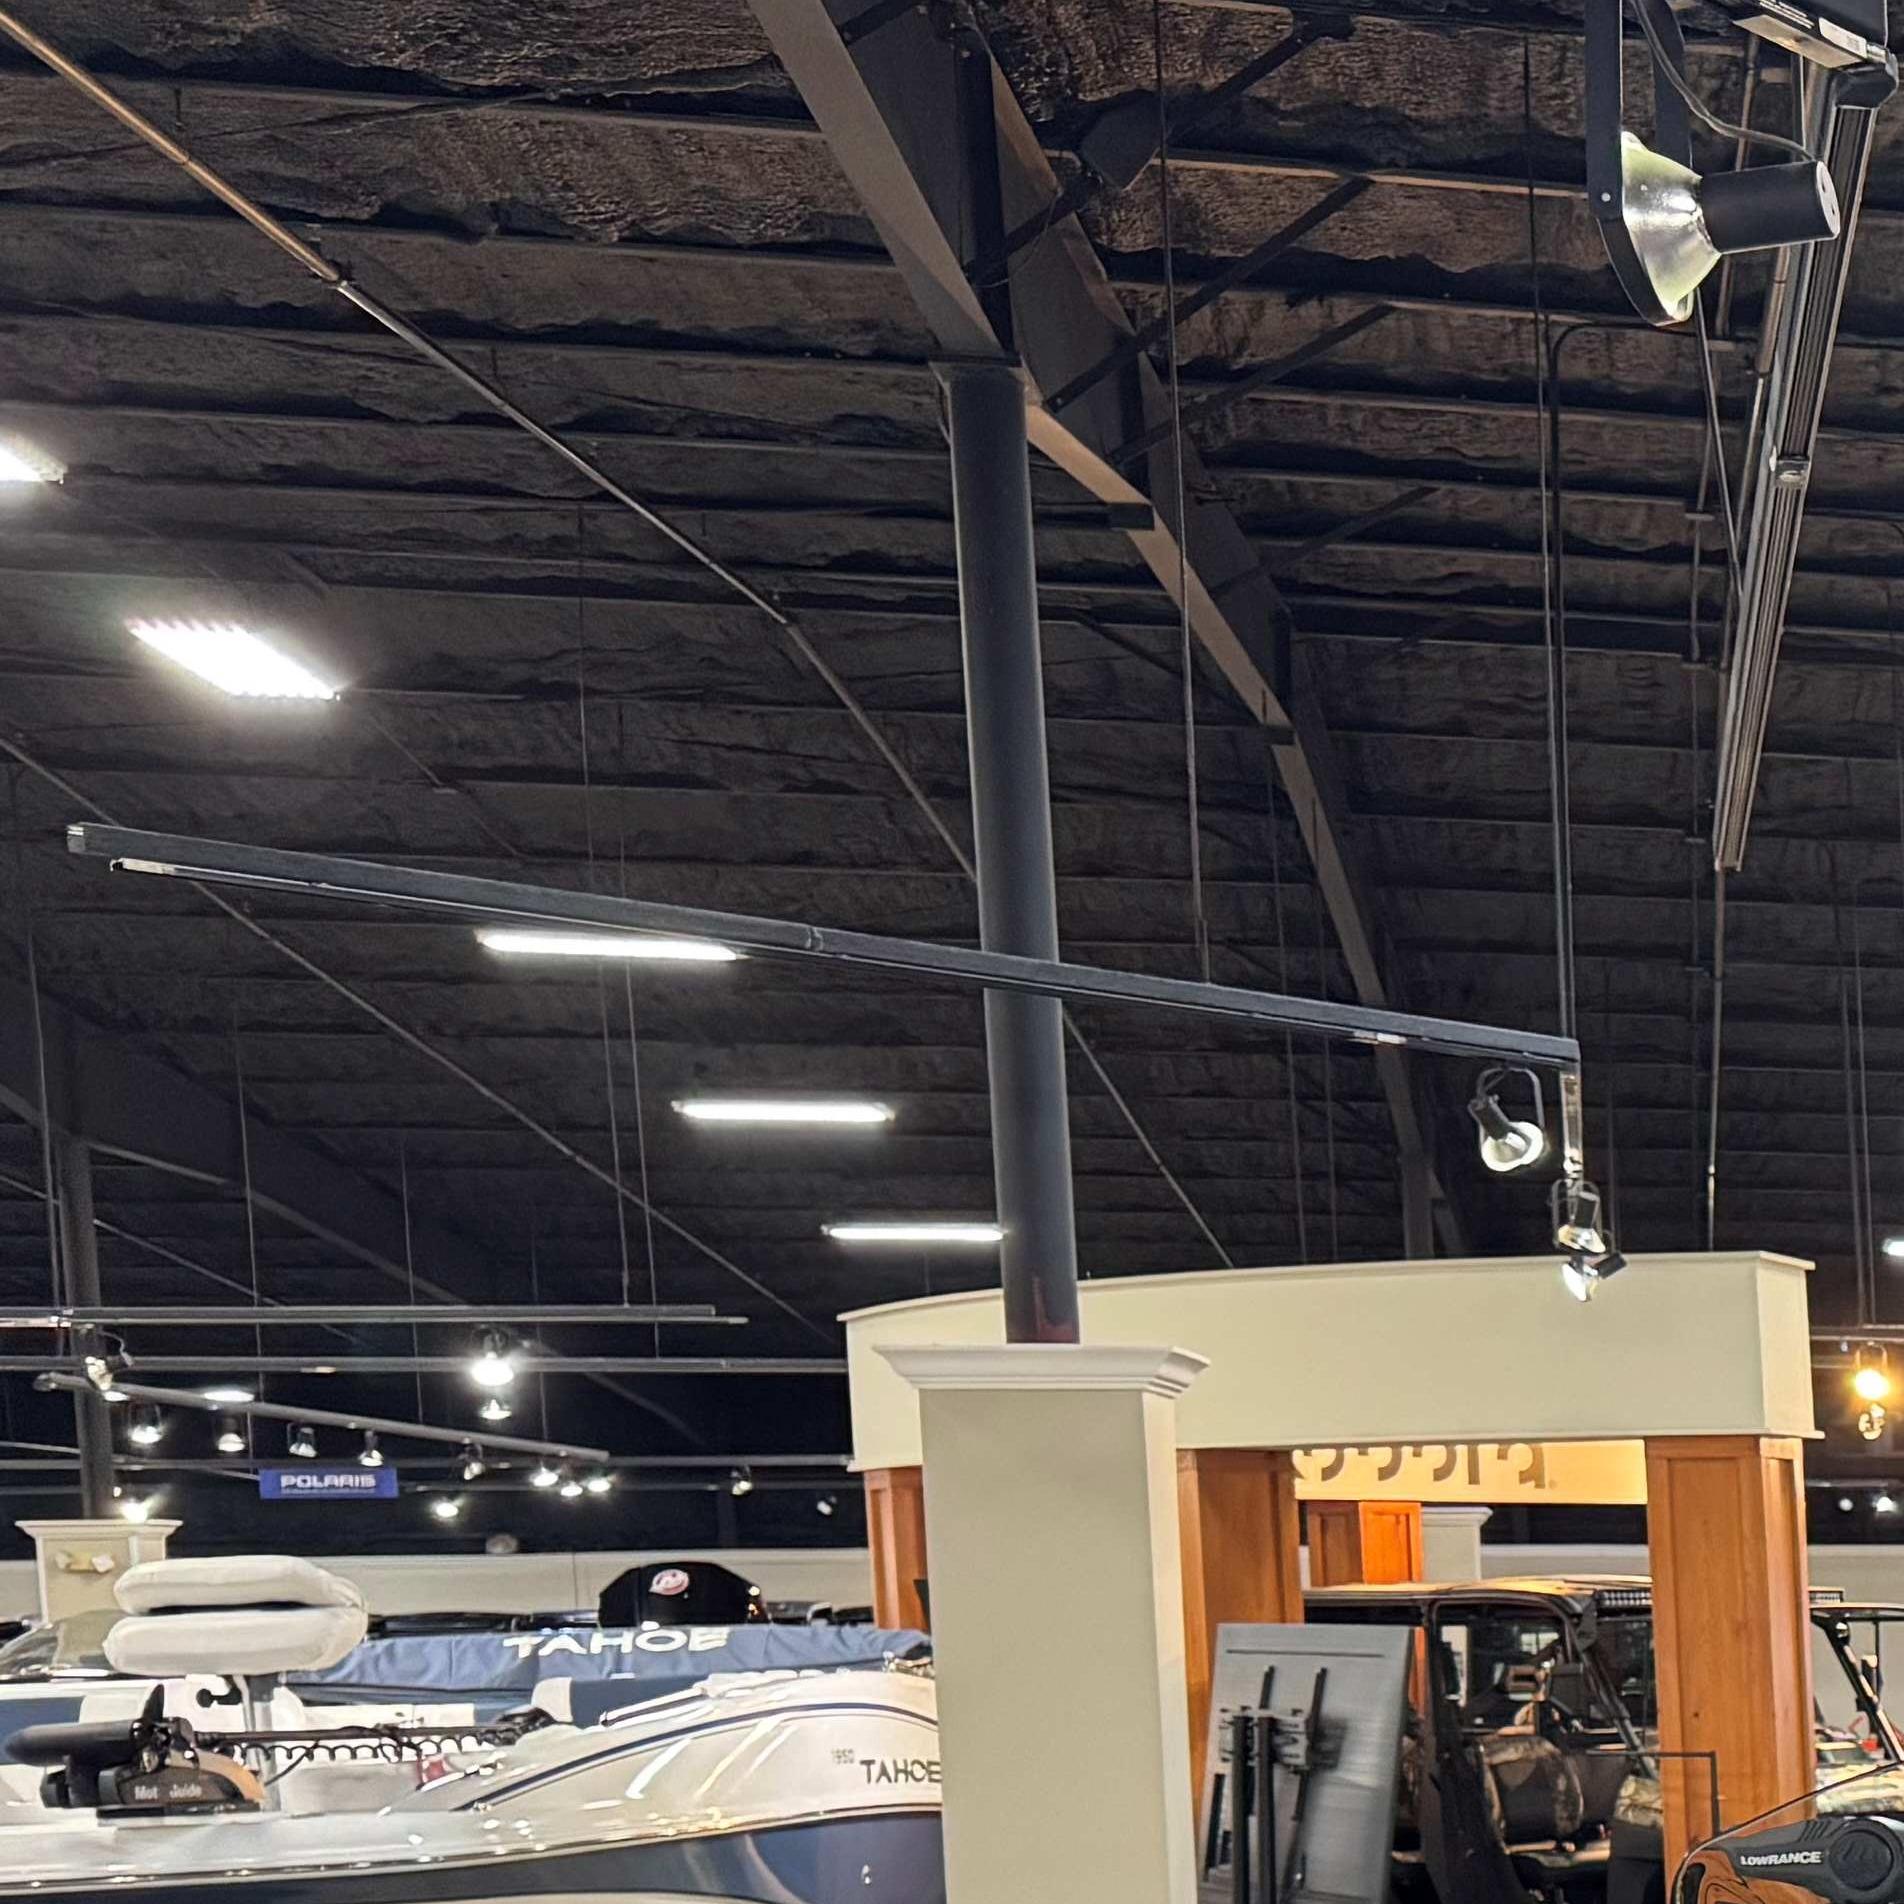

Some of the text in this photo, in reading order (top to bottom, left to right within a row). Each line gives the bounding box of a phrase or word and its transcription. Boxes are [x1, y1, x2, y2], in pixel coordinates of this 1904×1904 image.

[280, 1474, 377, 1489] POLARIS
[503, 1624, 731, 1659] TAHOE
[859, 1758, 943, 1785] TAHOE
[1740, 1851, 1822, 1866] LOWRANCE
